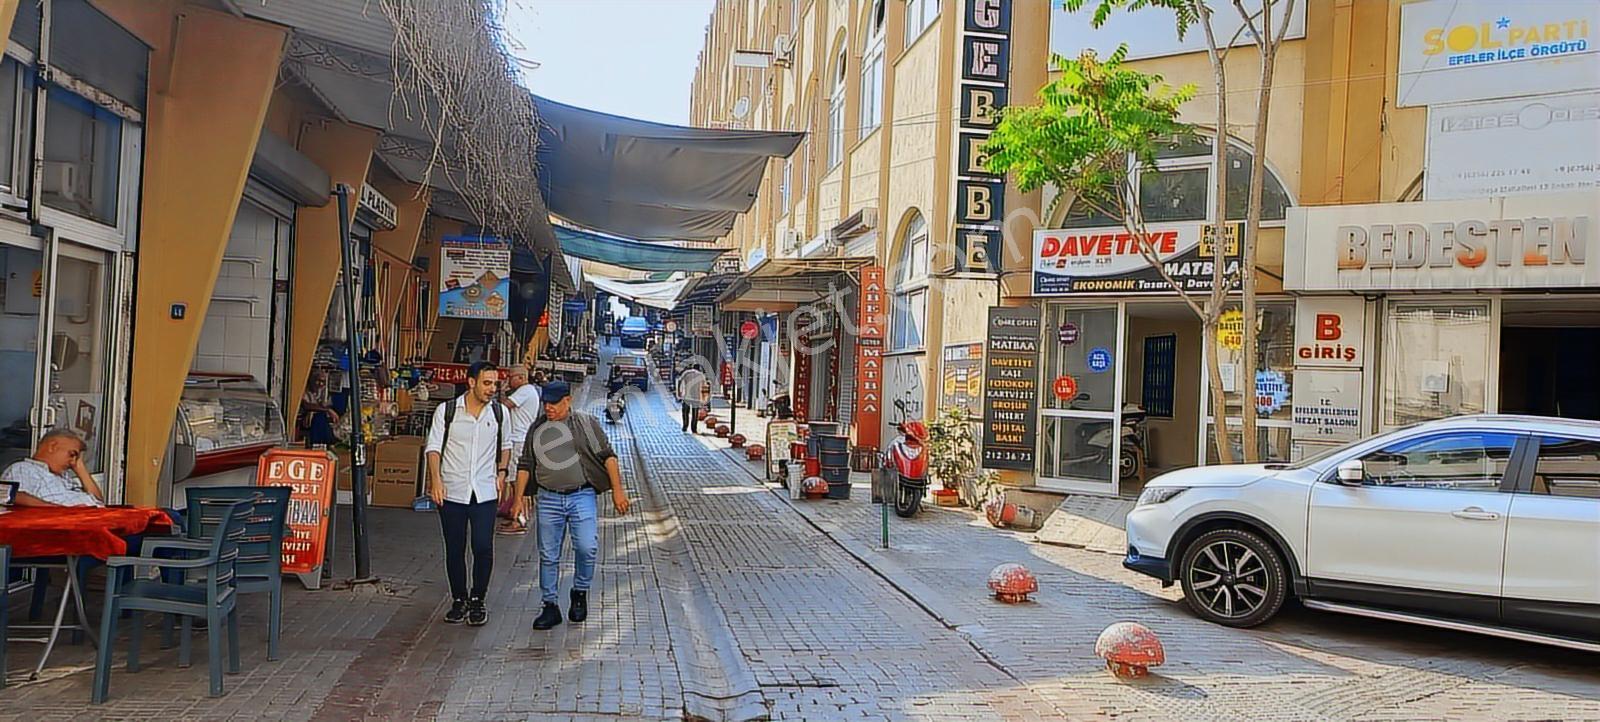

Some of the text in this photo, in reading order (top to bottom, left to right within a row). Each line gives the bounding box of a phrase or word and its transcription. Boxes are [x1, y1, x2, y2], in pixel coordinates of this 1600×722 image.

[1423, 19, 1590, 56] SOL PARTİ
[1449, 40, 1587, 66] EFELER İLÇE ÖRGÜTÜ
[1337, 215, 1589, 271] BEDESTEN
[1164, 261, 1241, 277] MATBA
[1073, 276, 1136, 290] EKONOMİK
[1315, 313, 1342, 341] B
[992, 341, 1035, 350] MATBAA
[1298, 343, 1357, 362] GİRİŞ
[863, 348, 880, 413] MATBAA
[1294, 416, 1359, 427] MEZAT SALONU
[995, 433, 1023, 443] BASKI
[269, 459, 325, 481] EGE
